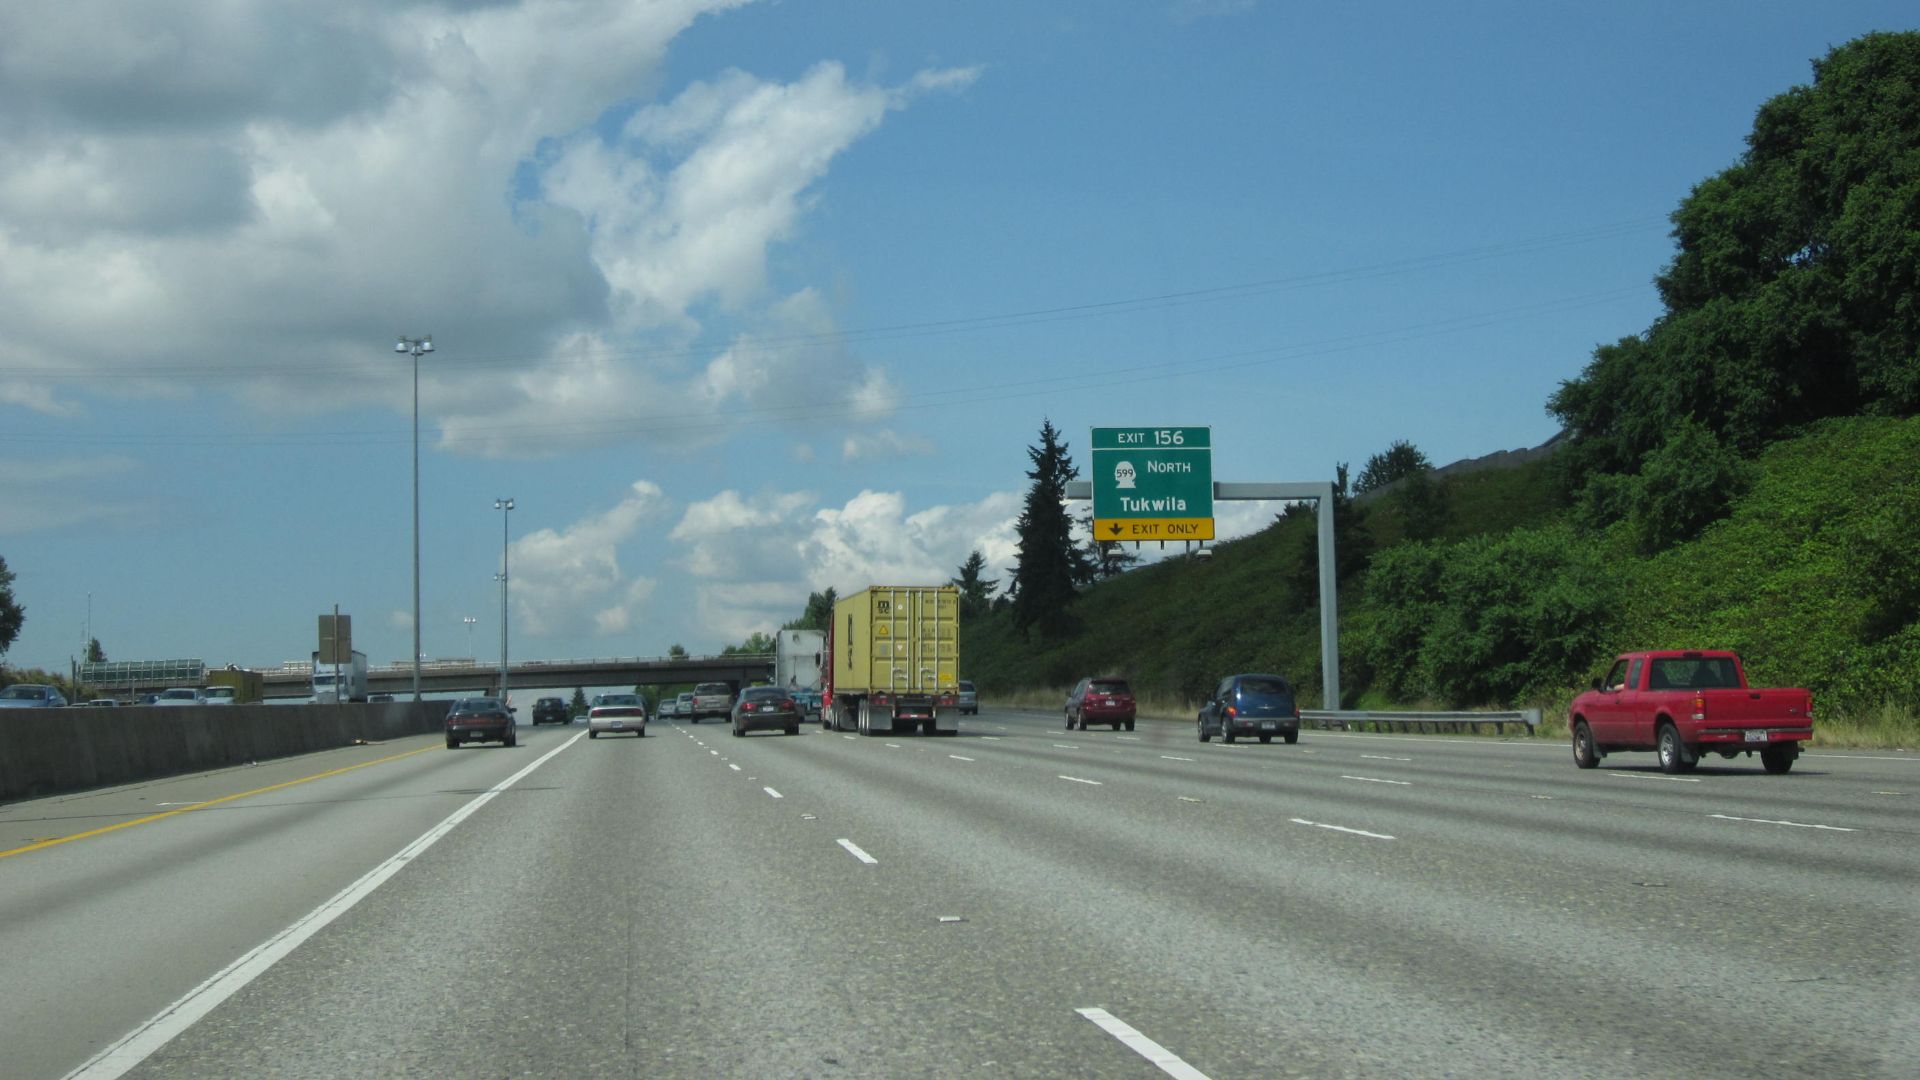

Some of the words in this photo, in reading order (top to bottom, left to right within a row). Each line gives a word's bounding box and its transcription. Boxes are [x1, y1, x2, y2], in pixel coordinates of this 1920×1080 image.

[1118, 433, 1145, 443] EXIT
[1154, 430, 1184, 445] 156
[1147, 460, 1191, 473] NORTH
[1116, 469, 1134, 478] 599
[1120, 496, 1187, 512] Tukwila
[1132, 524, 1160, 534] EXIT
[1167, 524, 1199, 534] ONLY
